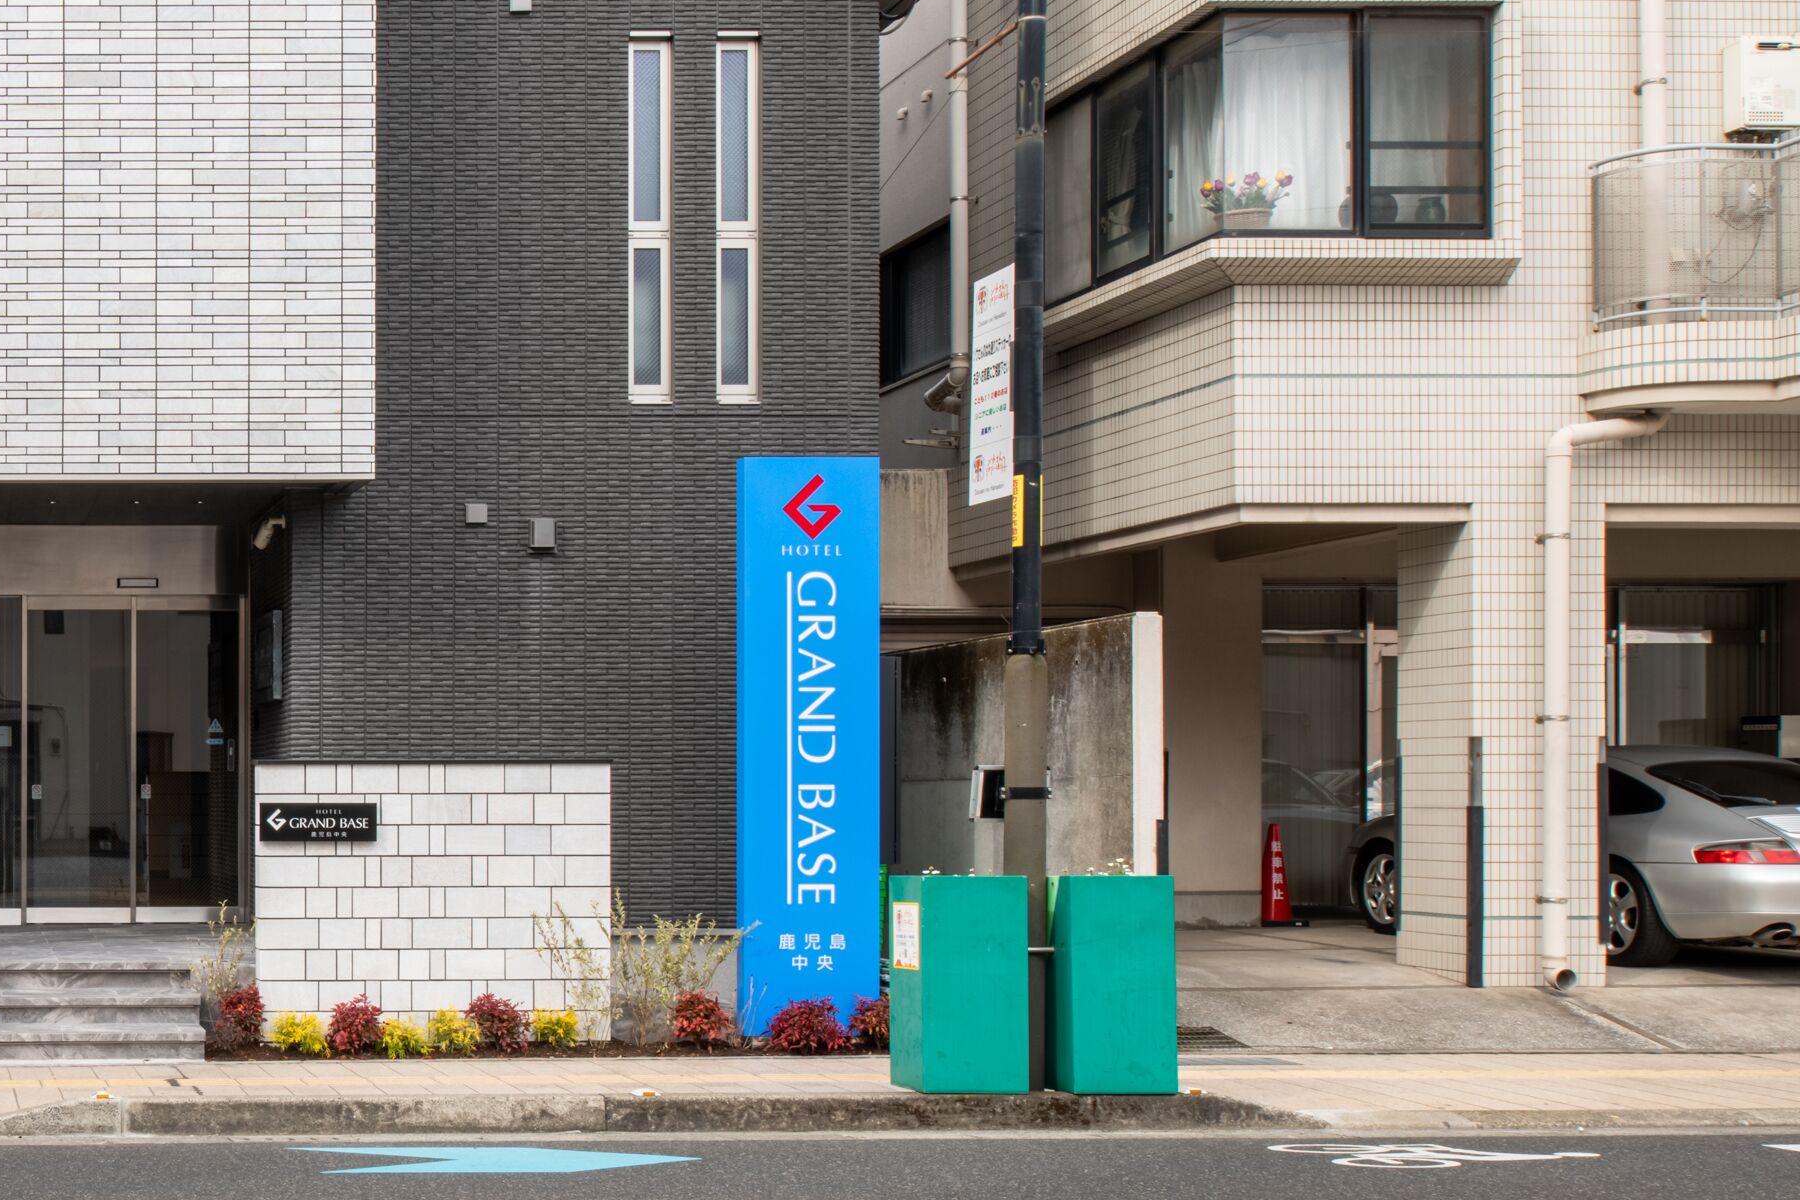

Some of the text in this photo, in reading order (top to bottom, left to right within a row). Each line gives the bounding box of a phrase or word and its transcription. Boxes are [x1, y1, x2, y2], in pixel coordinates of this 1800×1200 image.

[781, 544, 842, 557] HOTEL
[797, 570, 837, 905] GRAND BASE
[289, 817, 369, 829] GRAND BASE
[1271, 840, 1284, 901] 駐車禁止
[778, 933, 847, 951] 鹿児島
[791, 954, 834, 971] 中央
